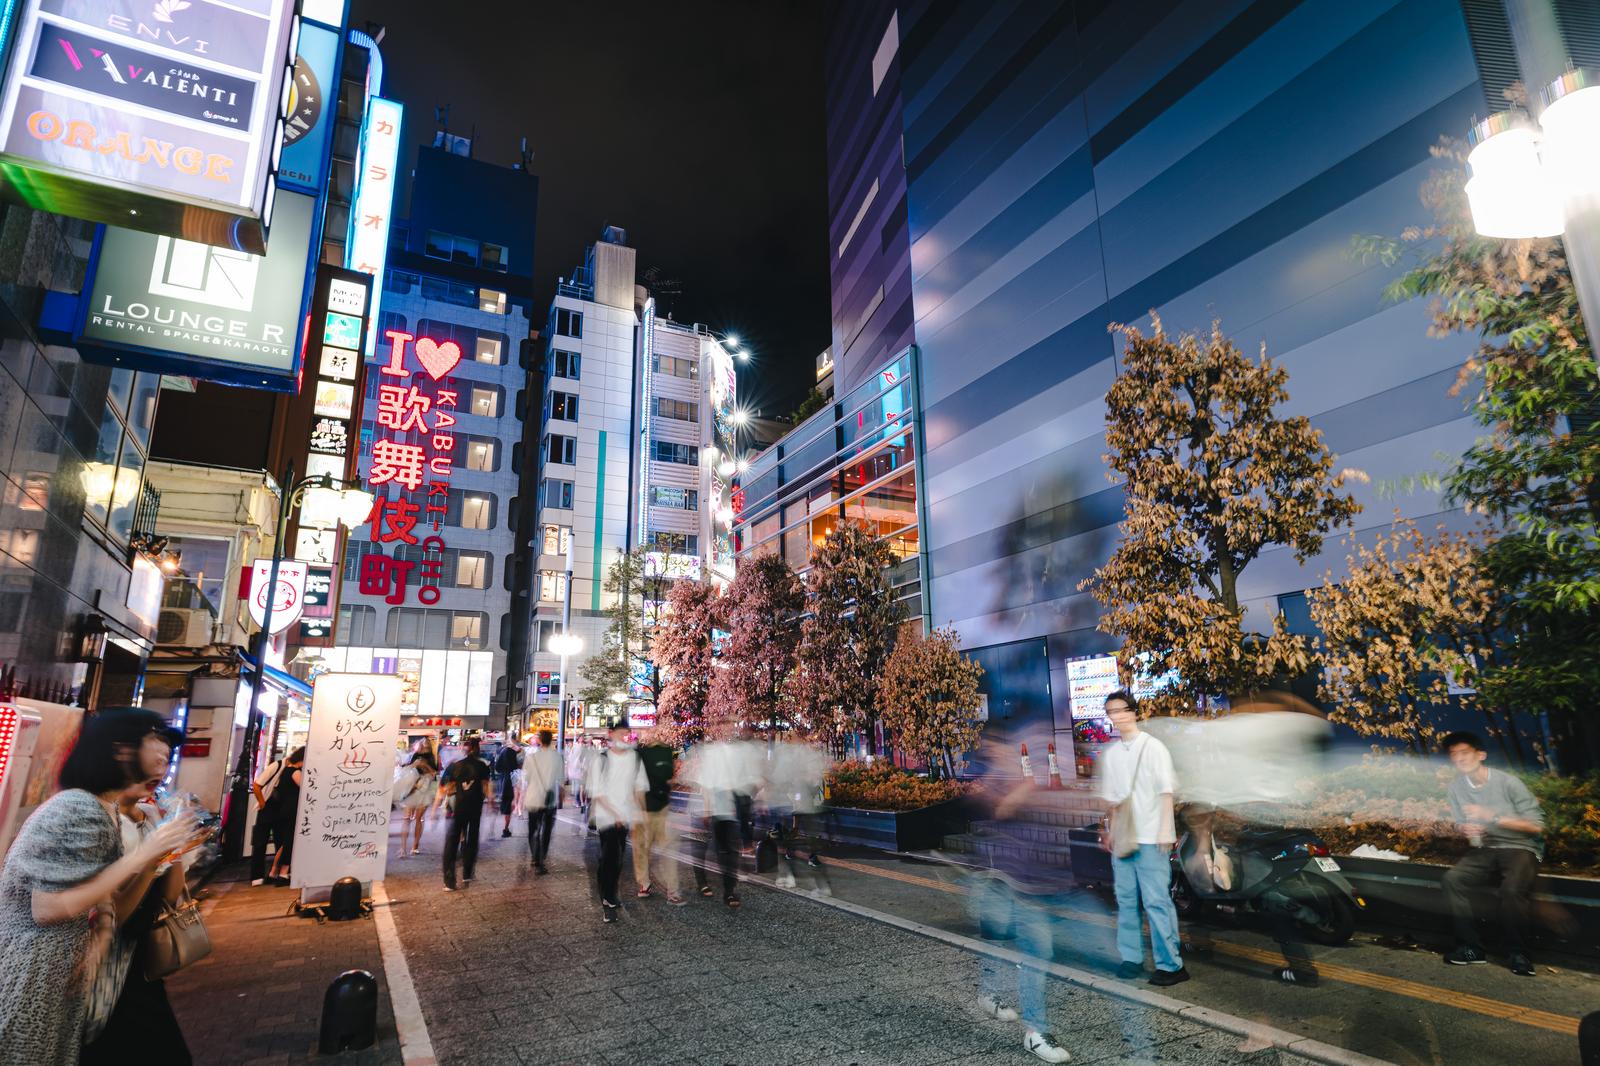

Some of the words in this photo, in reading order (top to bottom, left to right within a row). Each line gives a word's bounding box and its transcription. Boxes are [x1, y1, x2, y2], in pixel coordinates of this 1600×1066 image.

[106, 13, 209, 54] ENVI
[128, 64, 238, 106] VALENTI
[169, 68, 201, 81] club
[27, 110, 234, 182] ORANGE
[92, 316, 155, 334] RENTAL
[103, 295, 249, 338] LOUNGE
[261, 323, 285, 343] R
[381, 330, 413, 377] I
[359, 384, 431, 606] 歌舞伎町
[417, 389, 458, 606] KABUKI-CHO
[329, 736, 385, 750] カレー
[355, 811, 387, 826] TAPAS
